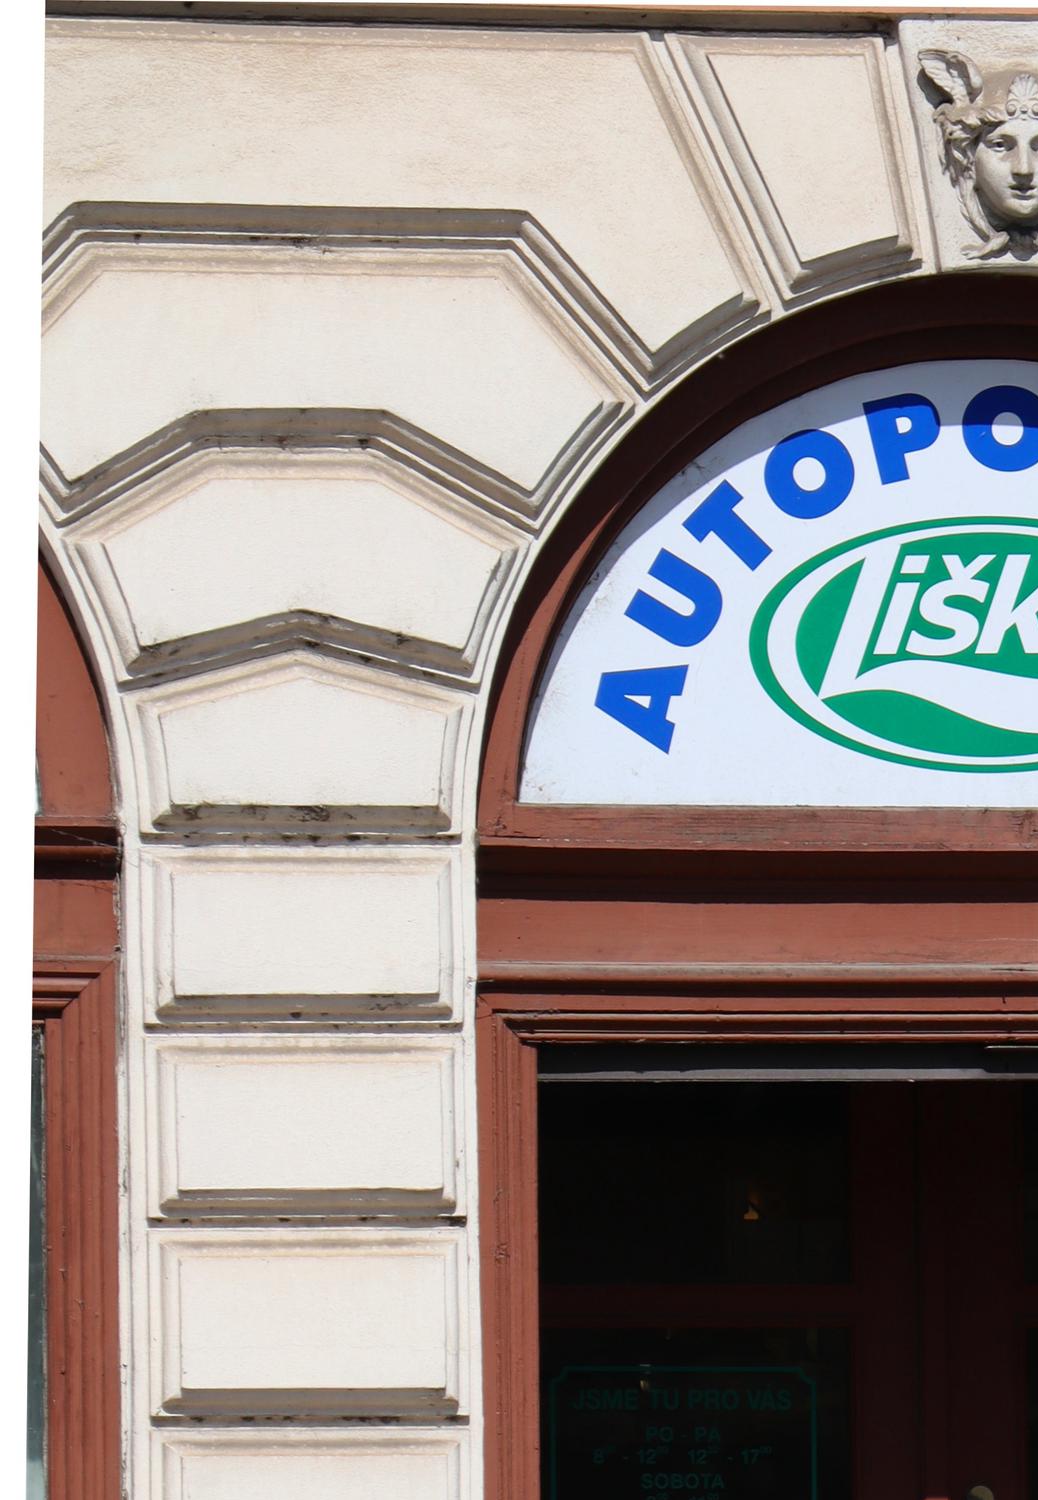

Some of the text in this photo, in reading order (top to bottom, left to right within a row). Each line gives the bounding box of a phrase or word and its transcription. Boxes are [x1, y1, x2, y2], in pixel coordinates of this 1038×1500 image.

[572, 1389, 640, 1410] JSME
[650, 1389, 680, 1410] TU
[688, 1389, 740, 1410] PRO
[645, 1426, 674, 1442] PO
[640, 1472, 725, 1489] SOBOTA
